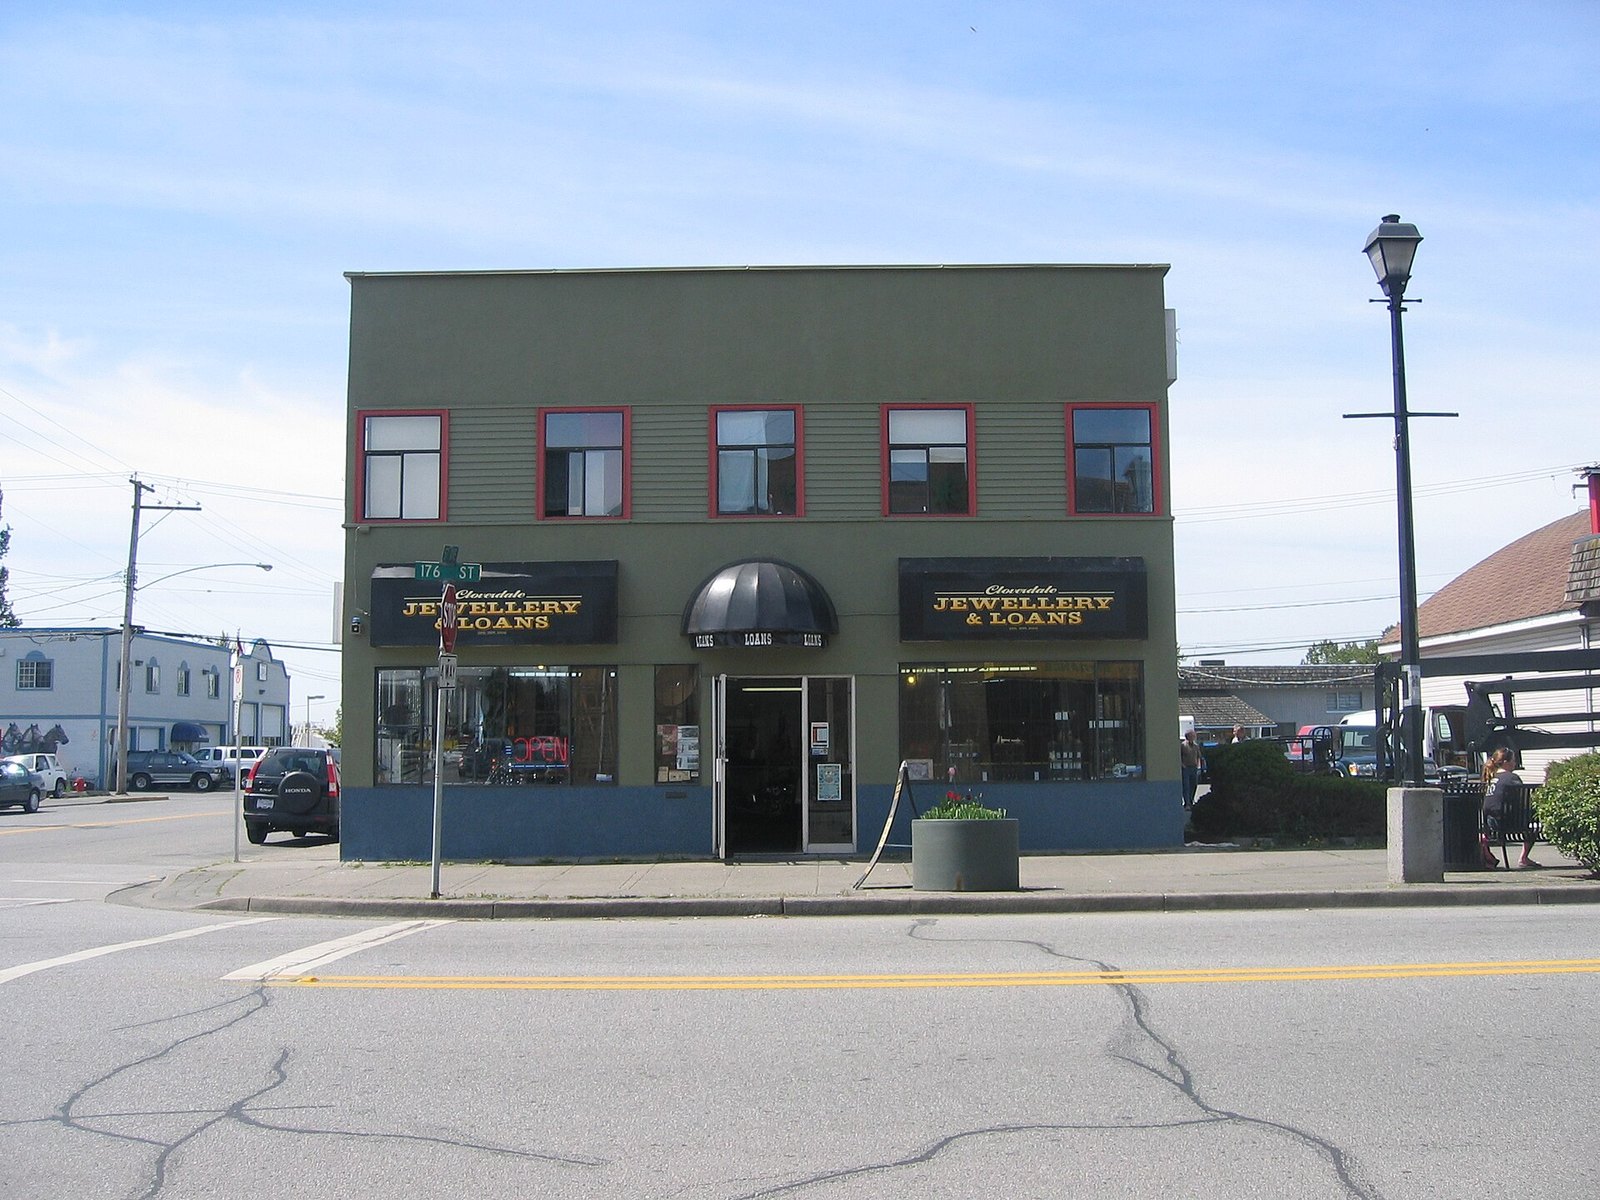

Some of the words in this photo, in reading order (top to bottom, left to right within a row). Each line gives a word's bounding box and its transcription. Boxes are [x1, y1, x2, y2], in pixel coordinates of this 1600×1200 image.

[420, 564, 441, 578] 176
[458, 566, 475, 579] ST
[455, 588, 526, 600] Cloverdale
[985, 584, 1058, 595] Cloverdale
[933, 596, 1114, 611] JEWELLERY
[457, 615, 550, 630] LOANS
[966, 612, 983, 625] &
[989, 611, 1082, 626] LOANS
[744, 632, 772, 646] LOANS
[513, 736, 568, 763] OPEN
